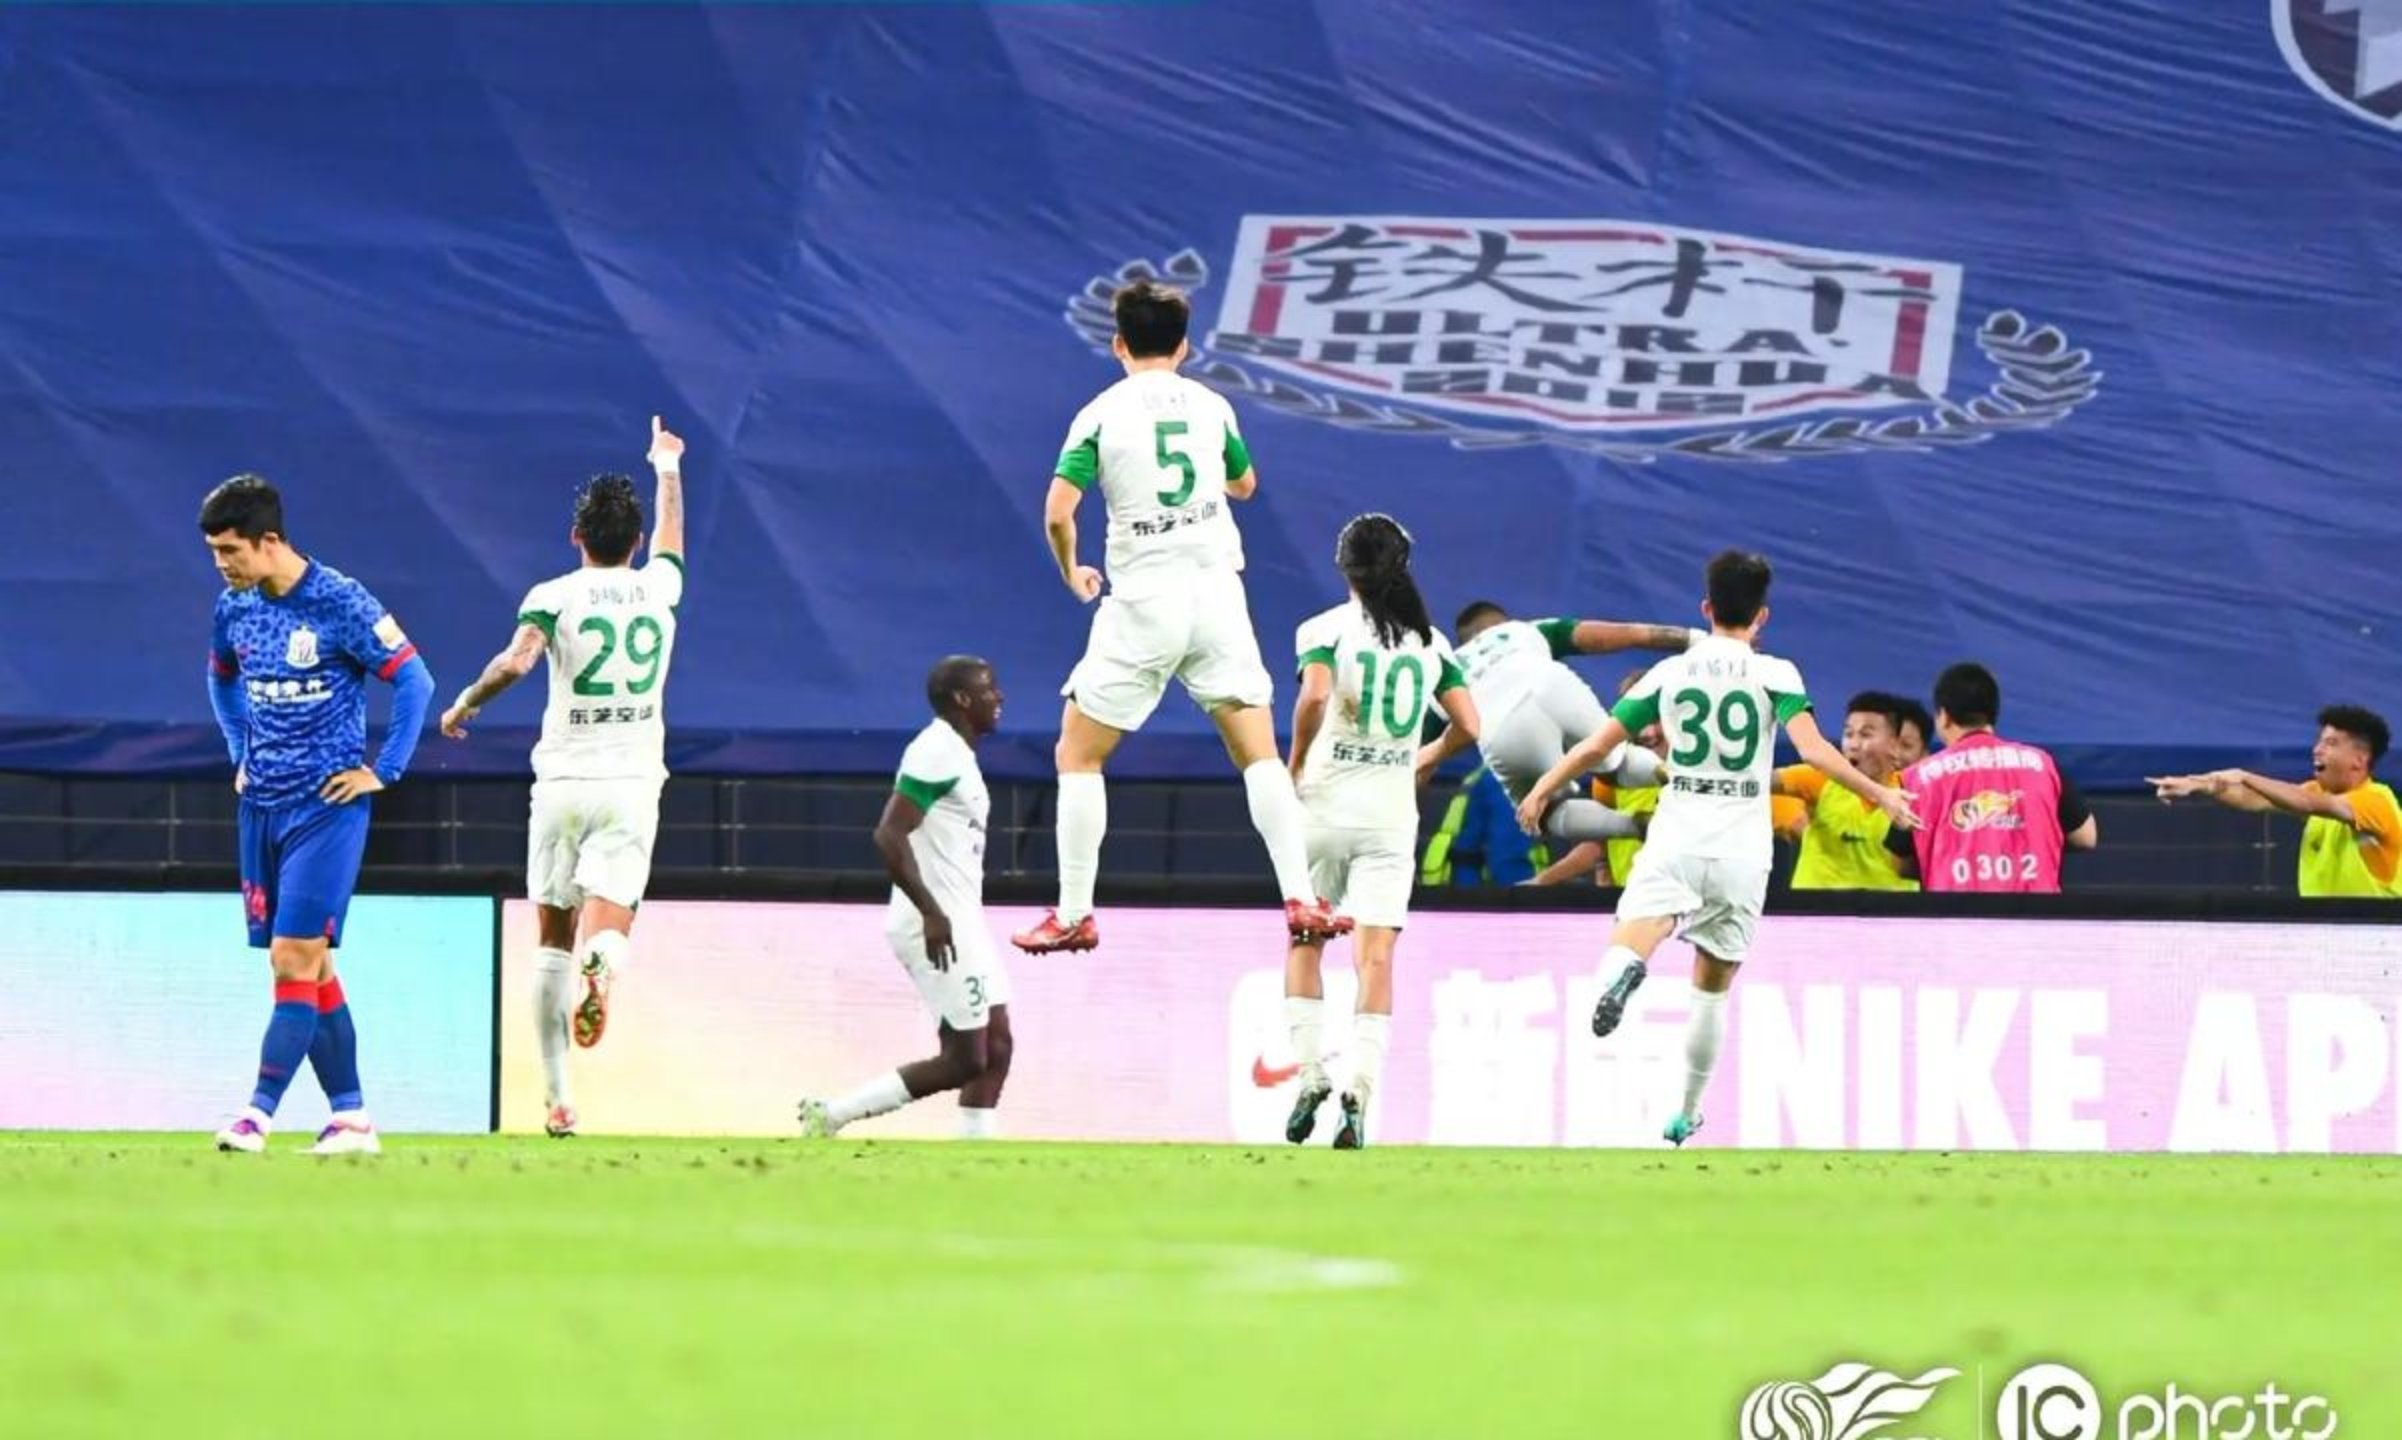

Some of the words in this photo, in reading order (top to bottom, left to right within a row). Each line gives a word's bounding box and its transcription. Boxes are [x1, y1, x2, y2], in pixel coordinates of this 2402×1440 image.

[1213, 333, 1933, 401] SHENHUA
[1155, 421, 1196, 507] 5
[573, 615, 662, 697] 29
[1356, 651, 1423, 738] 10
[1672, 687, 1759, 771] 39
[1952, 853, 2038, 884] 0302
